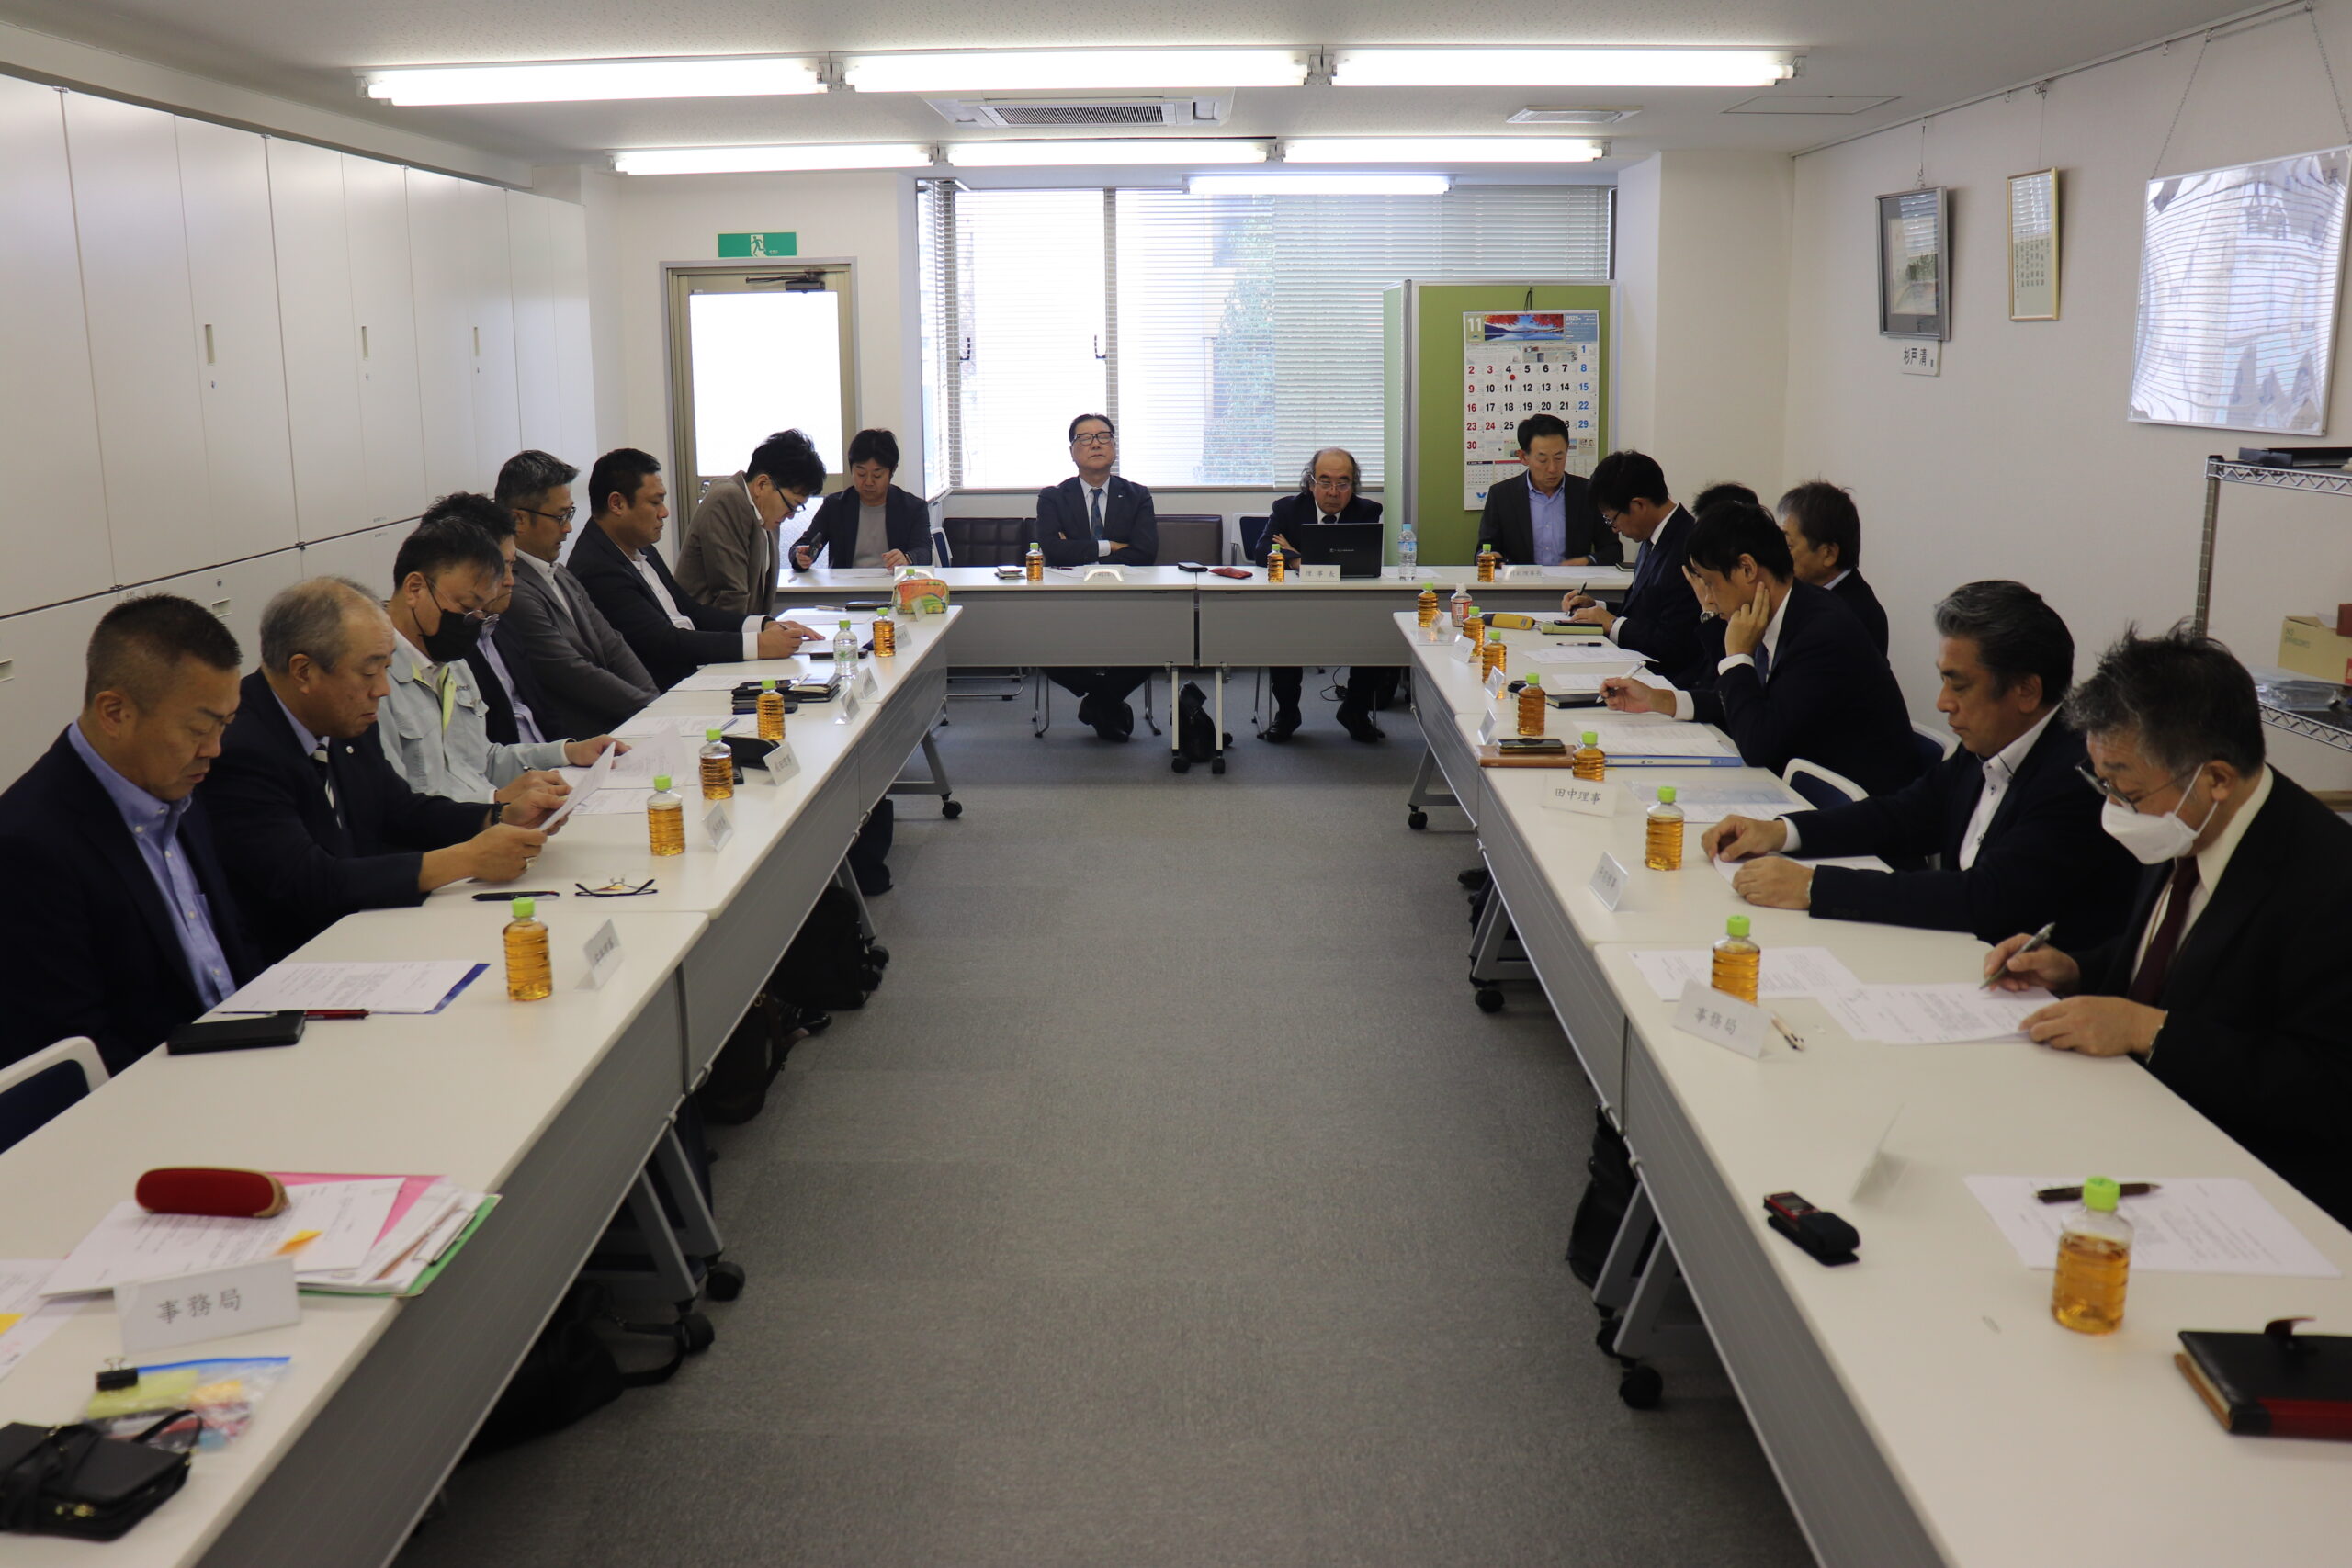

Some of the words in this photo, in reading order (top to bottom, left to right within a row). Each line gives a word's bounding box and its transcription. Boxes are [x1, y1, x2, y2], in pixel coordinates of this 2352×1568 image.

[1468, 318, 1482, 332] 11
[1581, 344, 1586, 354] 1
[1468, 367, 1475, 375] 2
[1487, 365, 1494, 374] 3
[1505, 366, 1512, 374] 4
[1524, 365, 1531, 373] 5
[1544, 365, 1549, 373] 6
[1562, 364, 1568, 373] 7
[1581, 363, 1588, 372] 8
[1468, 385, 1476, 393] 9
[1486, 384, 1495, 393] 10
[1504, 384, 1513, 392] 11
[1523, 383, 1532, 392] 12
[1542, 382, 1551, 392] 13
[1560, 382, 1569, 391] 14
[1579, 382, 1589, 391] 15
[1467, 404, 1476, 412] 16
[1486, 402, 1495, 412] 17
[1504, 402, 1514, 412] 18
[1523, 402, 1532, 411] 19
[1542, 402, 1551, 411] 20
[1559, 401, 1569, 411] 21
[1578, 400, 1589, 410] 22
[1467, 423, 1476, 431] 23
[1486, 423, 1495, 431] 24
[1504, 422, 1513, 430] 25
[1578, 420, 1589, 428] 29
[1467, 441, 1476, 449] 30
[1555, 788, 1601, 805] 田中理事
[1694, 1007, 1737, 1036] 事務局
[157, 1288, 243, 1324] 事務局
